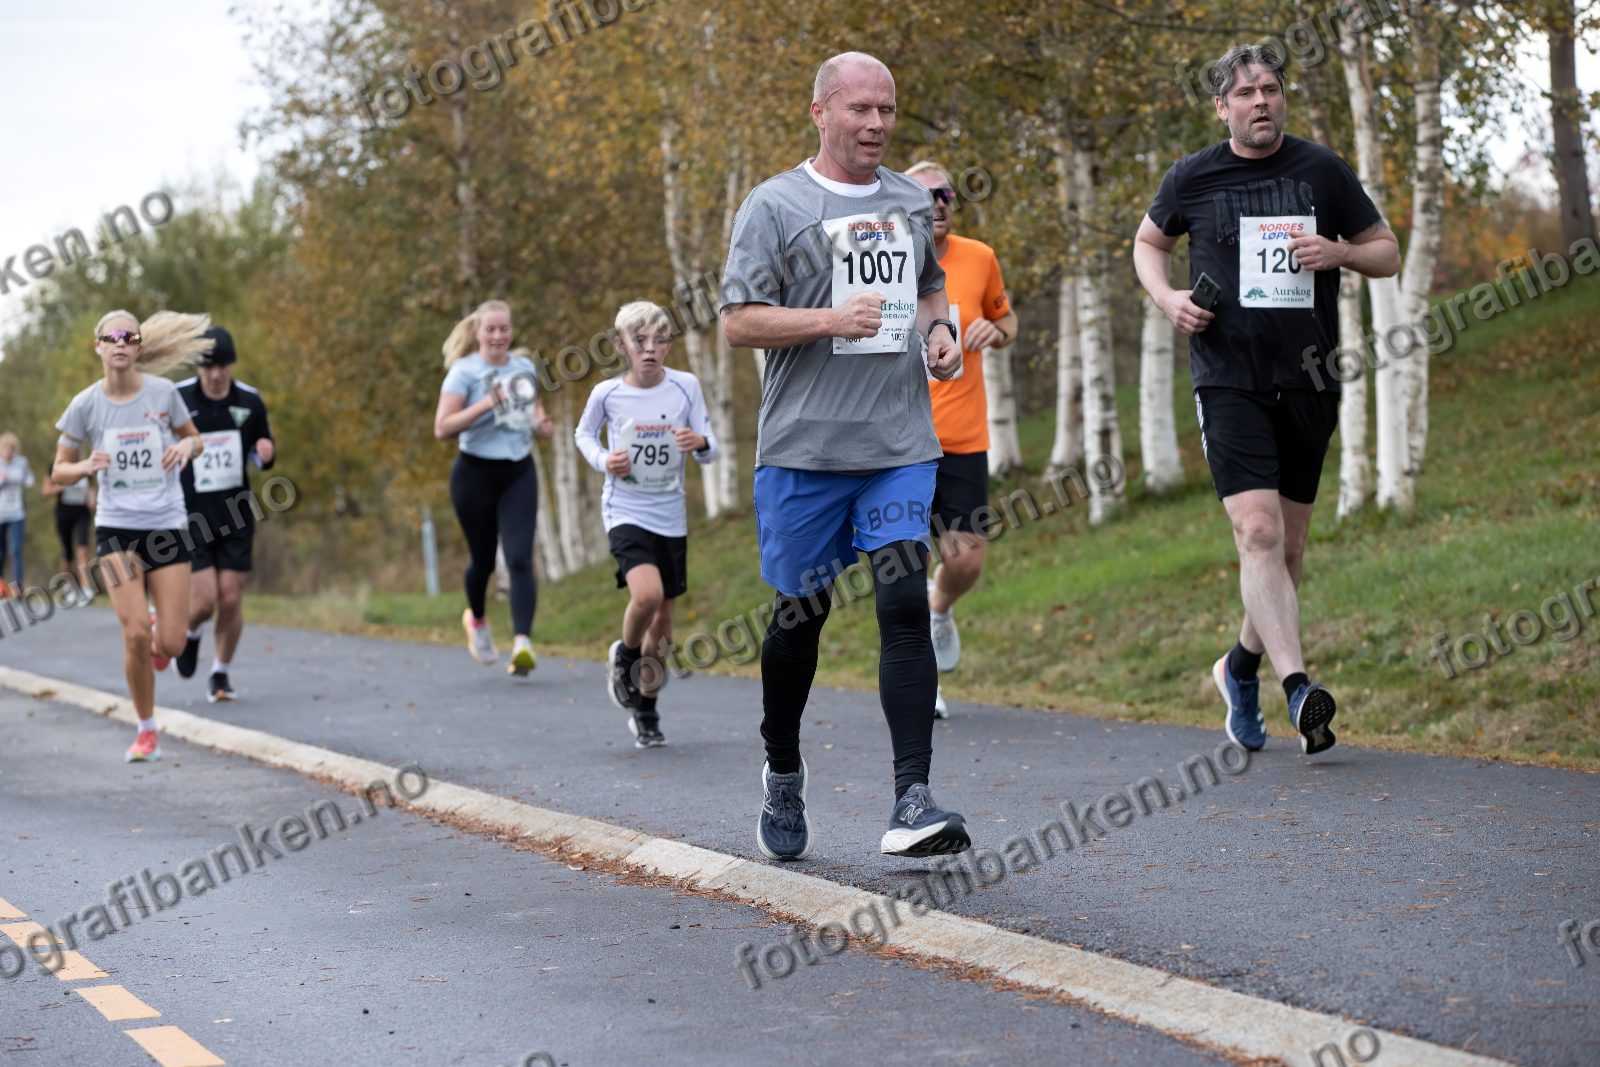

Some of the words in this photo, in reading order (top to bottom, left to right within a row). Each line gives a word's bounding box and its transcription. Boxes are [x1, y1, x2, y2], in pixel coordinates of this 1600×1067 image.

[848, 221, 895, 231] NORGES
[1258, 223, 1304, 232] NORGES
[855, 232, 889, 241] LØPET
[1262, 232, 1290, 240] LØPE
[843, 251, 907, 284] 1007
[1257, 248, 1301, 274] 120
[1272, 286, 1311, 298] Aurskog
[881, 300, 914, 314] urskog
[117, 449, 152, 471] 942
[203, 451, 233, 470] 212
[631, 444, 669, 466] 795
[867, 500, 931, 532] BOR
